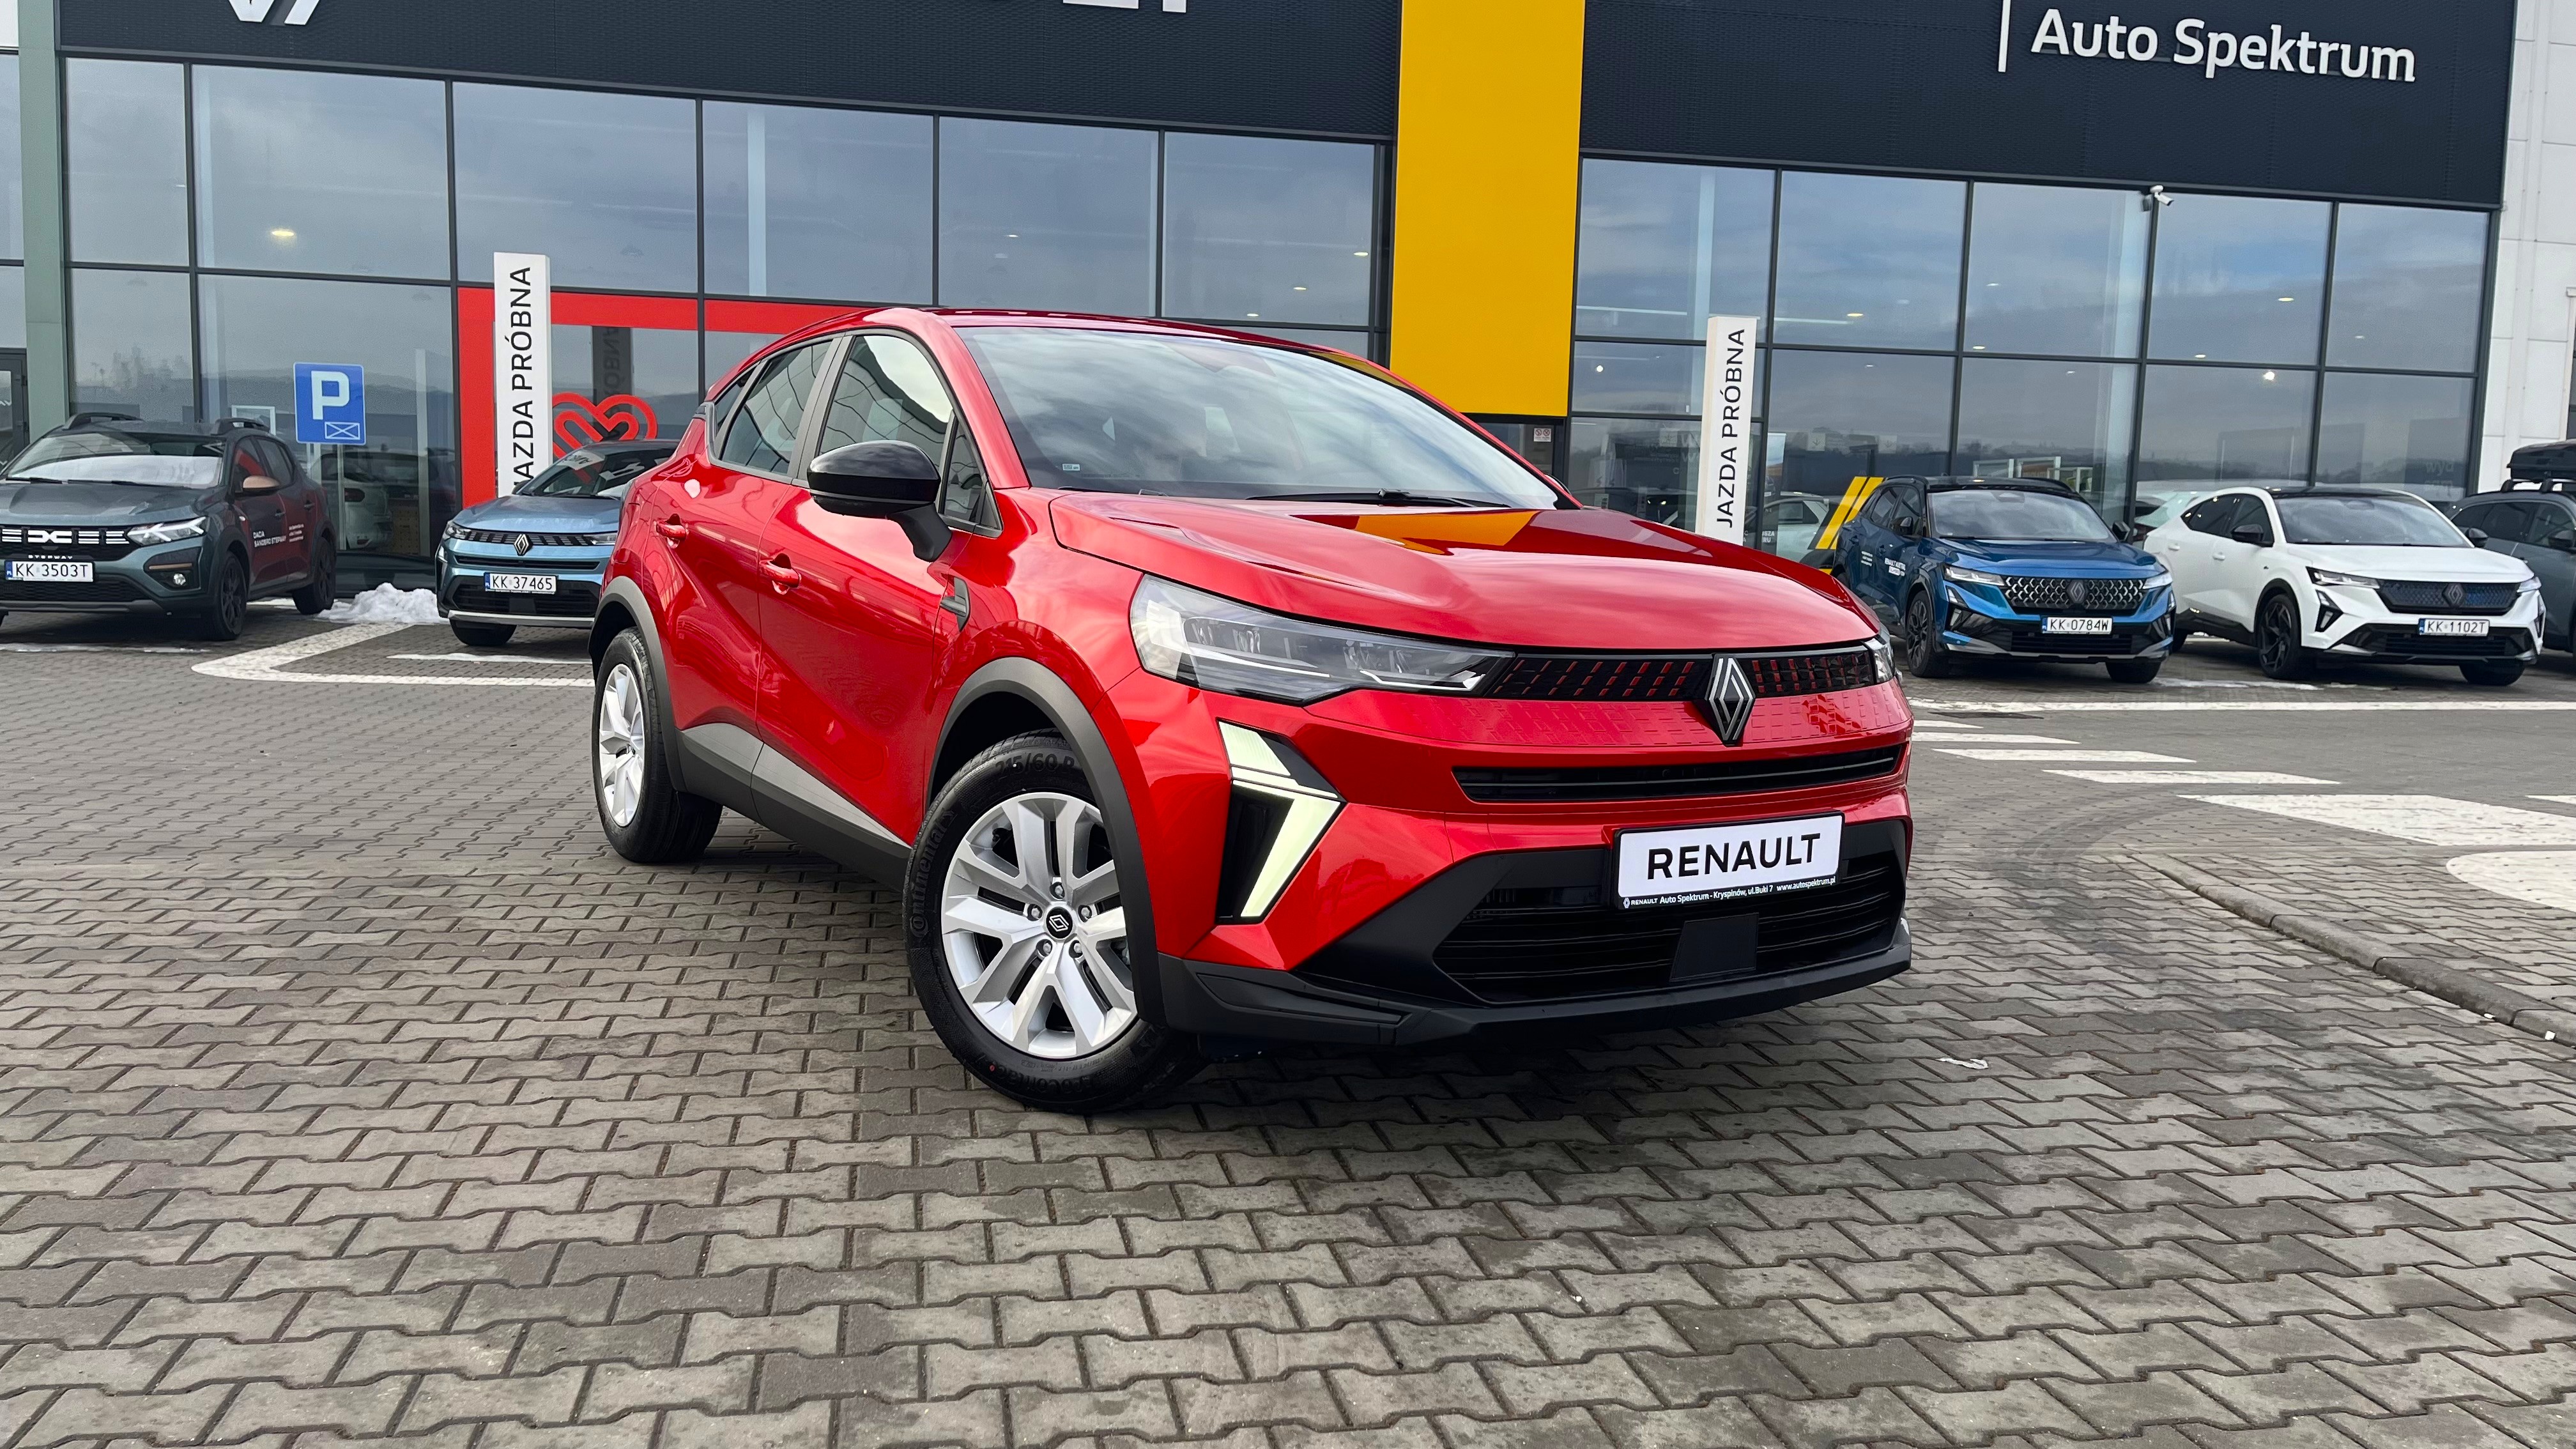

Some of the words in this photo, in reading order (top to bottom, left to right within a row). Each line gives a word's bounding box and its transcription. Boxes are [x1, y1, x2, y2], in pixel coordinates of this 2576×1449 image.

[2031, 8, 2158, 61] Auto
[2174, 18, 2416, 82] Spektrum
[505, 267, 533, 391] PRÓBNA
[311, 371, 349, 420] P
[1720, 329, 1745, 438] PRÓBNA
[512, 400, 535, 487] AZDA
[1717, 446, 1737, 528] JAZDA
[16, 563, 34, 577] KK
[42, 564, 88, 578] 3503T
[493, 575, 508, 588] KK
[513, 576, 553, 590] 37465
[2050, 618, 2067, 631] KK
[2071, 619, 2109, 631] 0784W
[2428, 620, 2444, 632] KK
[2450, 621, 2486, 633] 1102T
[1647, 832, 1821, 880] RENAULT
[1659, 896, 1676, 904] Auto
[1677, 893, 1710, 904] Spektrum
[1713, 888, 1747, 900] Kryspinów,
[1776, 876, 1836, 892] www.autospektrum.pl
